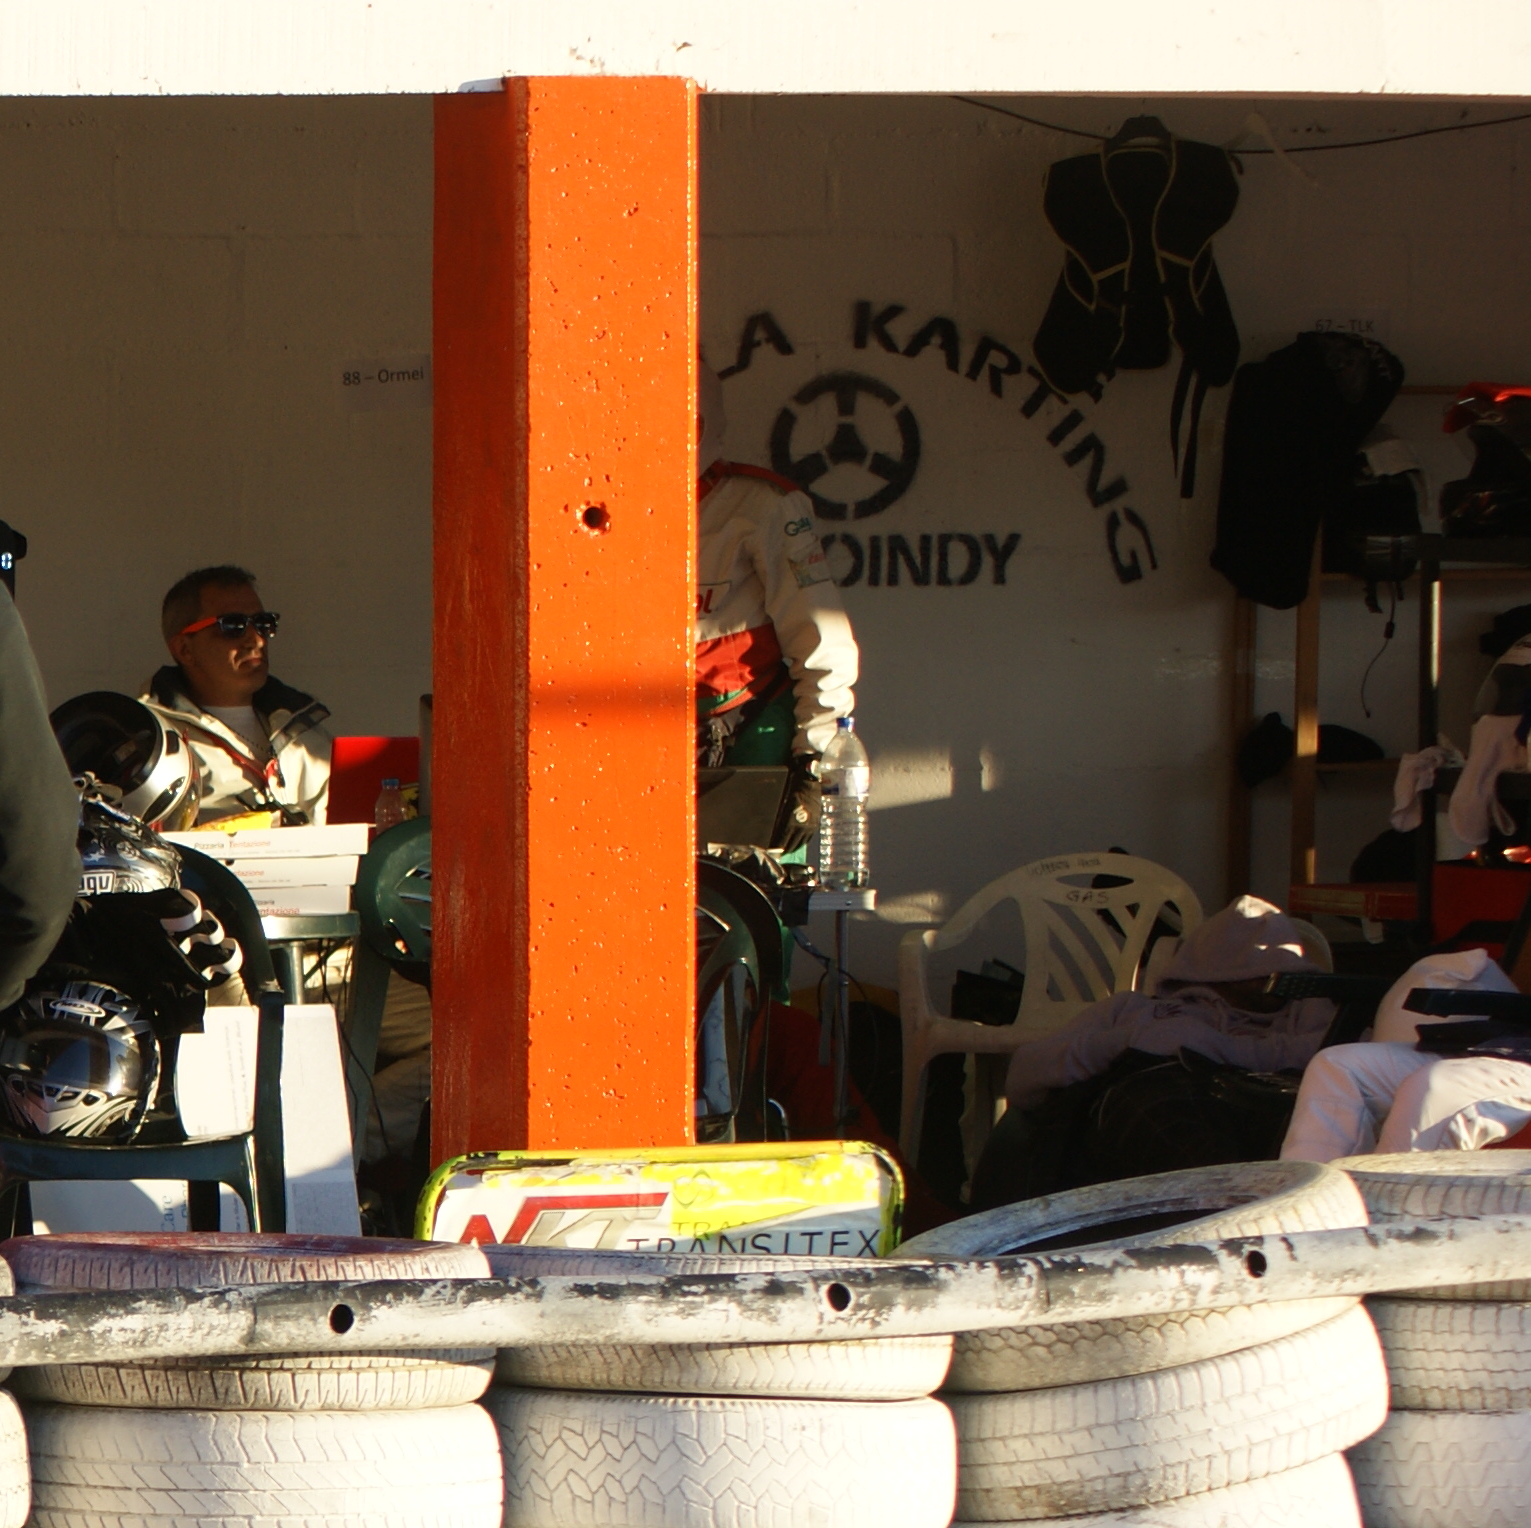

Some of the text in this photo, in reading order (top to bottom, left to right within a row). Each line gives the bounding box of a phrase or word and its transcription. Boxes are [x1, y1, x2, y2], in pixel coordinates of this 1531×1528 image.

[342, 370, 361, 387] 88
[719, 301, 1158, 585] A KARTING
[819, 532, 1022, 587] OINDY
[626, 1229, 881, 1258] TRANSITEX
